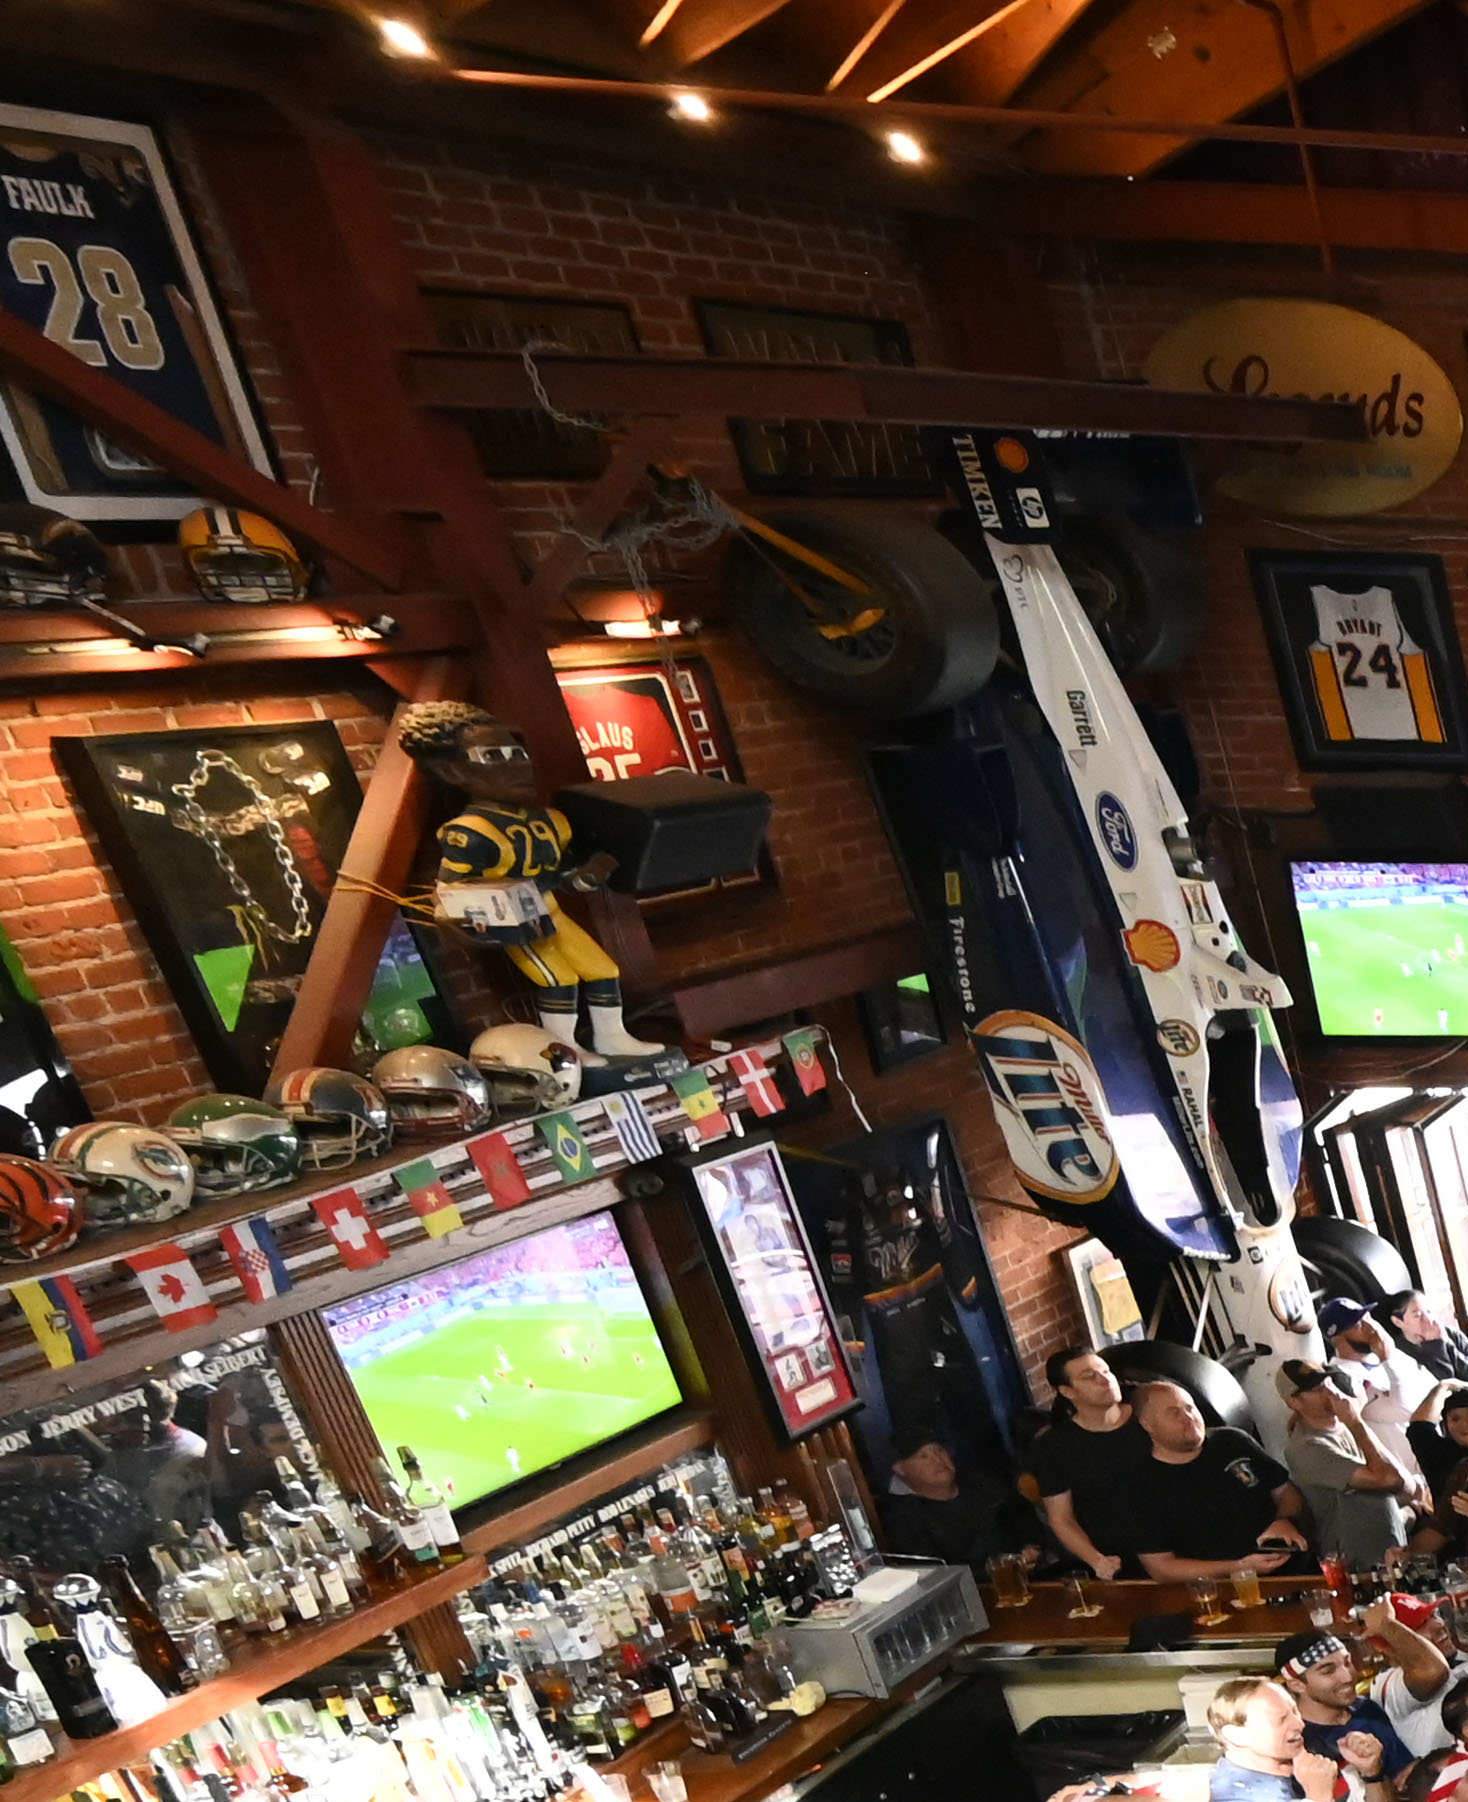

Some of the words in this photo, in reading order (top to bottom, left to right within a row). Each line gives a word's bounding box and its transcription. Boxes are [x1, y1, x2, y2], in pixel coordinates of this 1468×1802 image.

[3, 174, 96, 221] FAULK
[8, 237, 164, 371] 28
[951, 433, 1004, 529] TIMKEN
[1336, 618, 1382, 639] BRYANT
[1336, 641, 1402, 690] 24
[1065, 688, 1099, 749] Garrett
[505, 820, 562, 876] 29
[1100, 805, 1134, 860] Ford
[948, 916, 975, 1014] Firestone
[988, 1033, 1103, 1183] Lite
[1058, 1061, 1111, 1146] Miller
[1181, 1087, 1204, 1130] RAHAL
[203, 1344, 267, 1382] SEIBERT
[40, 1406, 99, 1439] JERRY
[96, 1387, 149, 1418] WEST
[566, 1514, 597, 1539] PETTY
